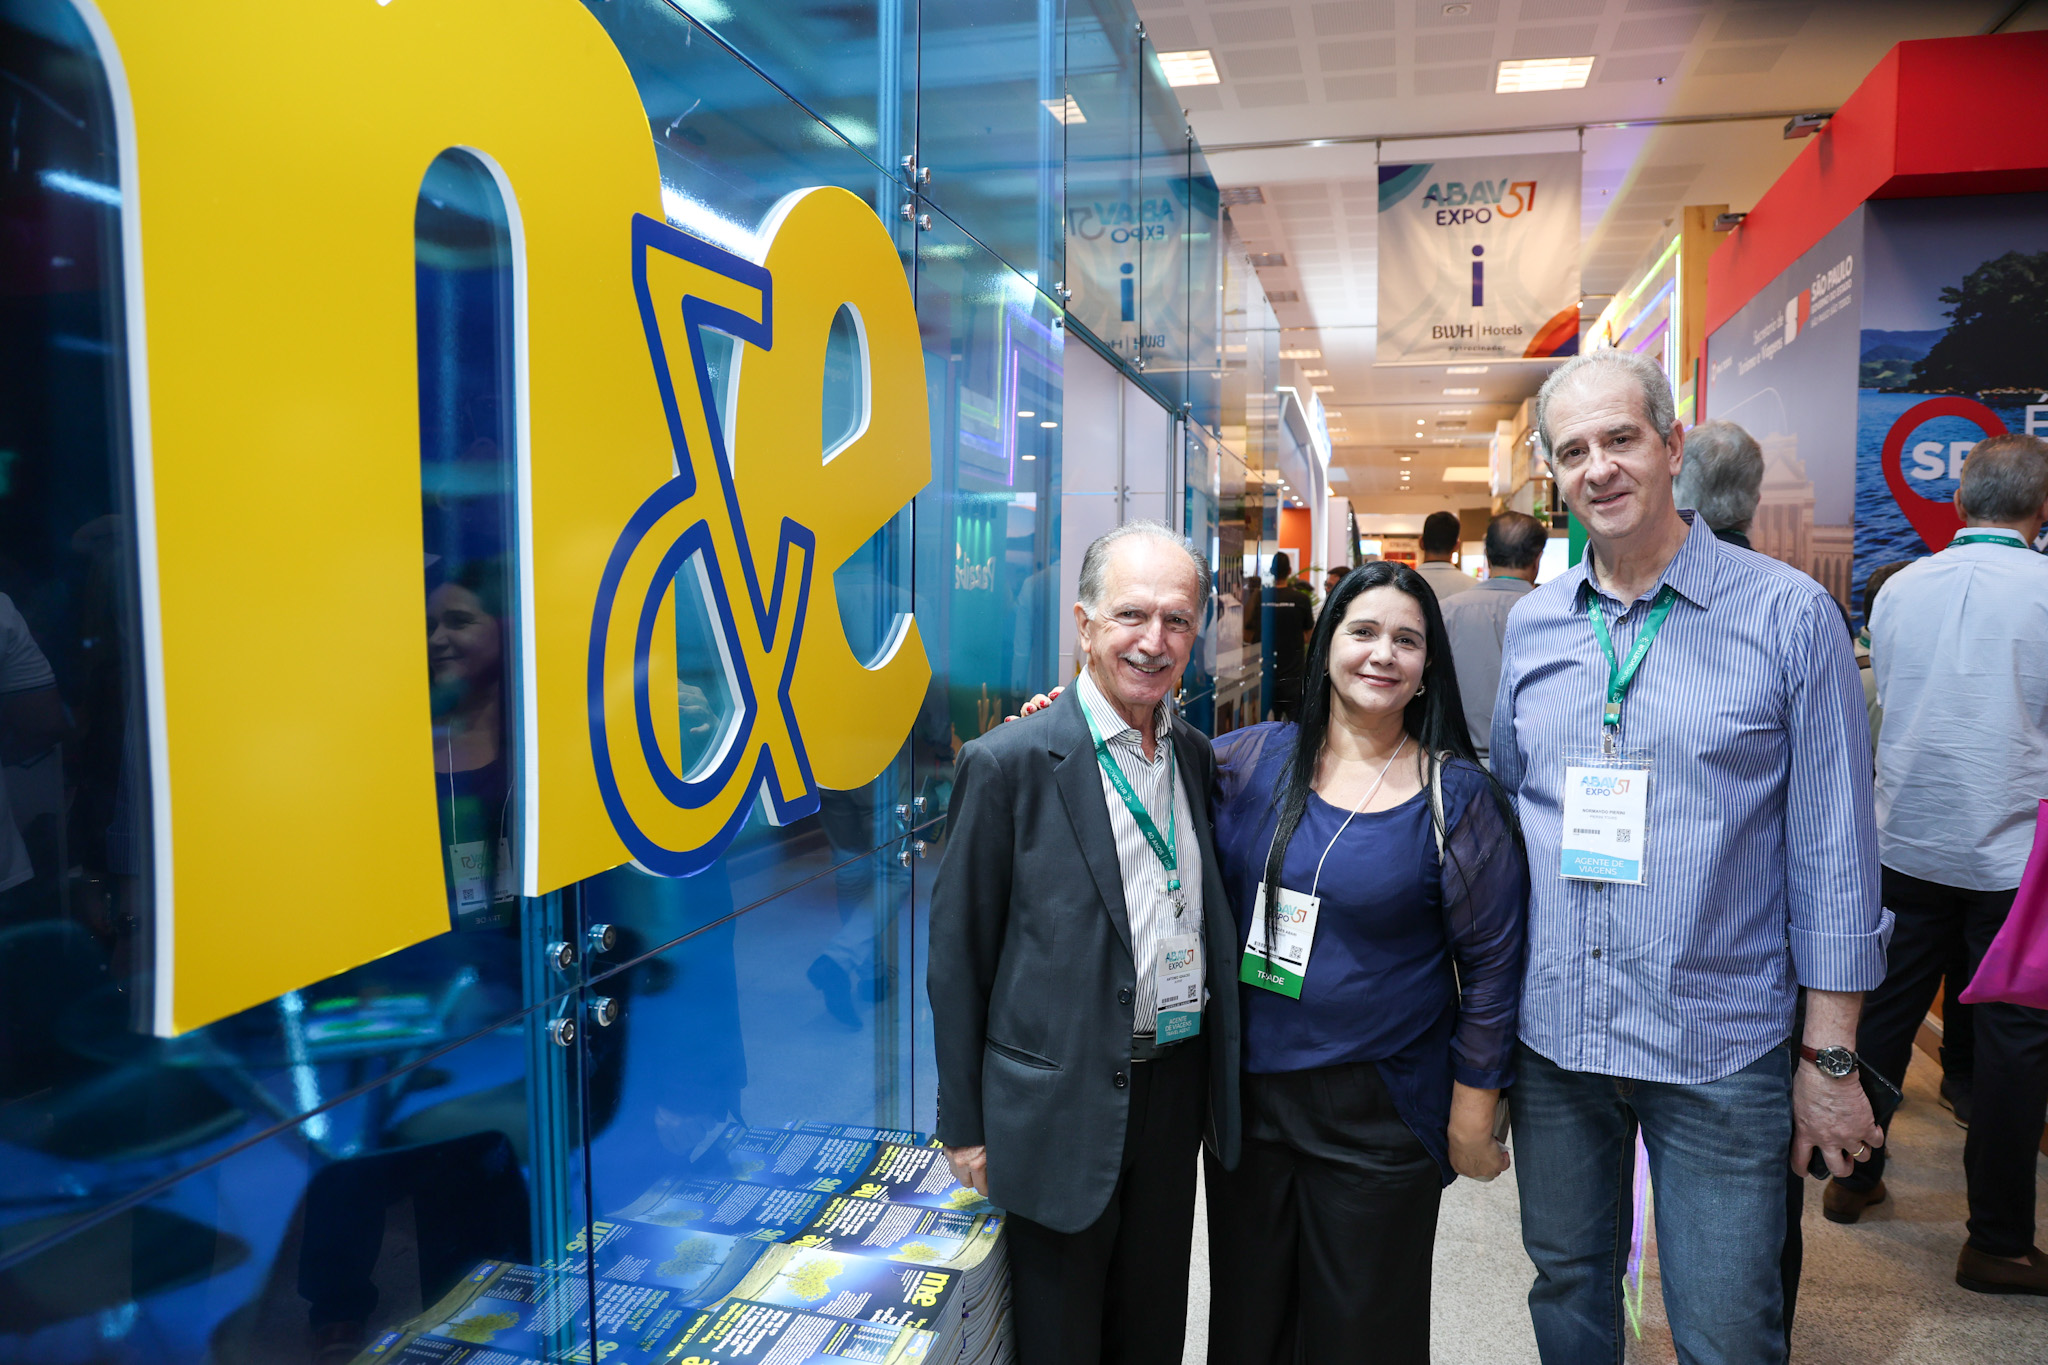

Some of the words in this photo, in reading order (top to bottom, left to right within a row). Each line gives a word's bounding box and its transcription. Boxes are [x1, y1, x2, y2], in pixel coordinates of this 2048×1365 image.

[1437, 208, 1492, 226] EXPO
[1812, 274, 1827, 301] SÃO
[1828, 255, 1853, 290] PAULO
[1433, 324, 1472, 339] BWH
[1483, 324, 1522, 336] Hotels
[1586, 788, 1610, 796] EXPO
[1152, 840, 1164, 855] ANOS
[1574, 857, 1609, 866] AGENTE
[1611, 860, 1624, 868] DE
[1579, 865, 1617, 875] VIAGENS
[1169, 961, 1183, 970] EXPO
[1257, 970, 1285, 985] TRADE
[1169, 1016, 1187, 1024] AGENTE
[1172, 1020, 1192, 1030] VIAGENS
